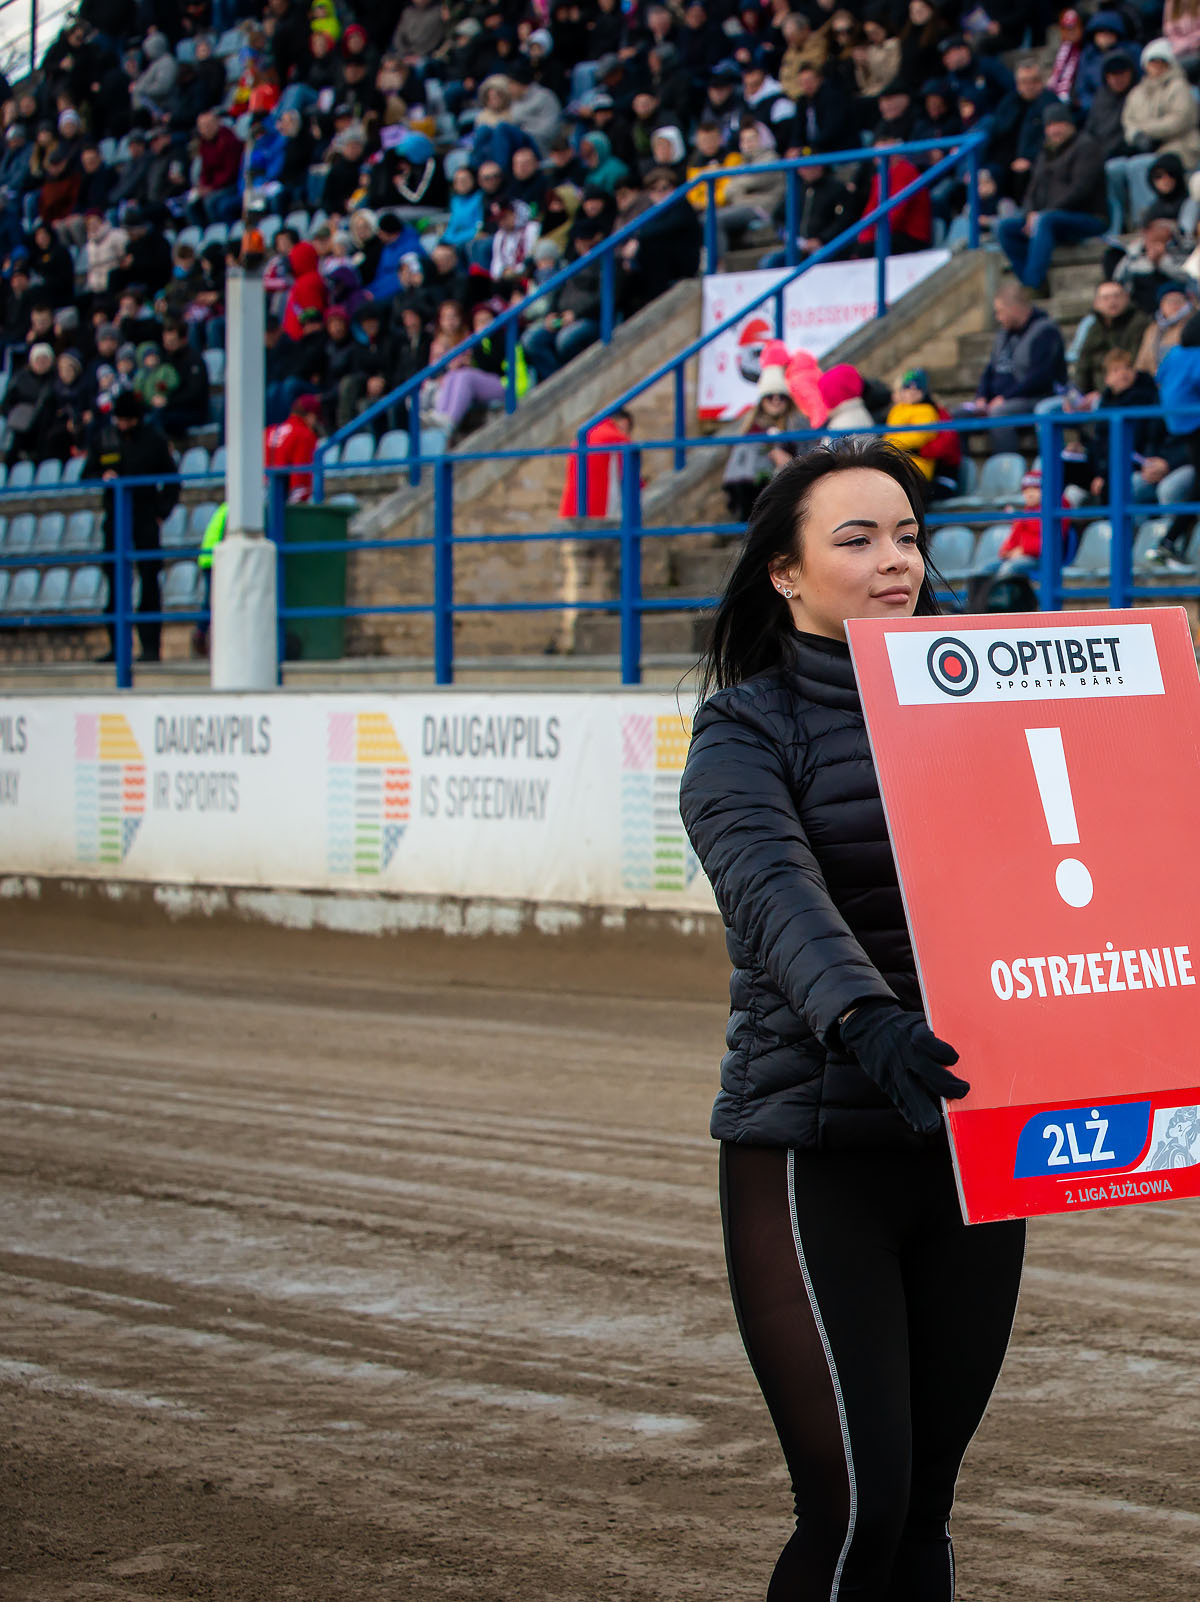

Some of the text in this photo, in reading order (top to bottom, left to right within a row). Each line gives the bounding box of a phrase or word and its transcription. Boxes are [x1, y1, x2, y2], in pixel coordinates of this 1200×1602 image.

[987, 638, 1121, 677] OPTIBET
[996, 676, 1124, 689] SPORTA BĀRS
[155, 715, 270, 755] DAUGAVPILS
[422, 715, 561, 760] DAUGAVPILS
[175, 771, 240, 813] SPORTS
[420, 774, 551, 820] IS SPEEDWAY
[990, 941, 1196, 1000] OSTRZEŻENIE
[1042, 1109, 1115, 1166] 2LŻ
[1065, 1179, 1173, 1204] 2. LIGA ŻUŻLOWA
